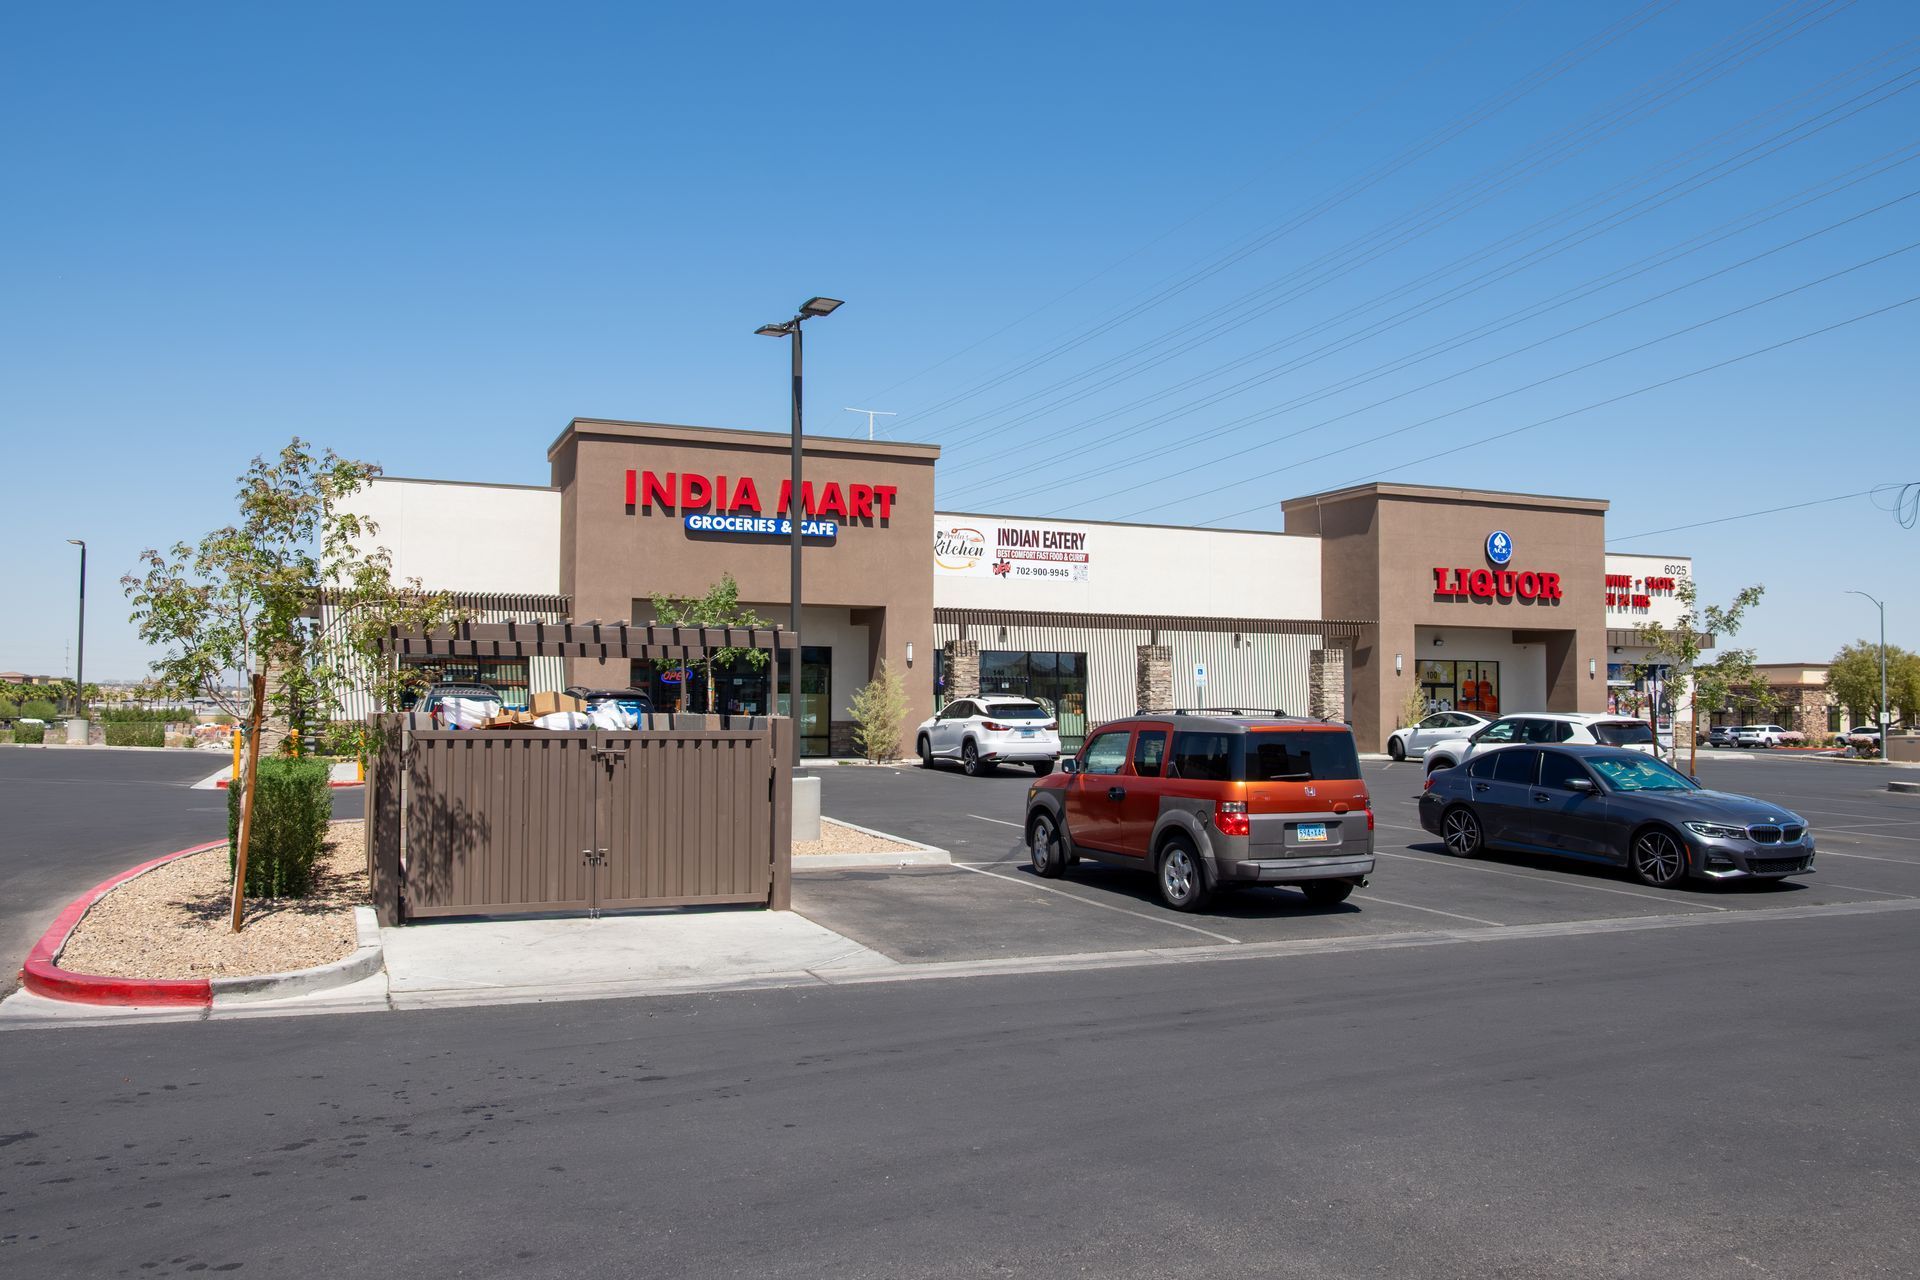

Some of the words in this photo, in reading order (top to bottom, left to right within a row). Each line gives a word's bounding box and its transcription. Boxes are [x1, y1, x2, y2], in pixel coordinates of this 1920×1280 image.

[626, 470, 762, 512] INDIA
[777, 480, 897, 519] MART
[689, 516, 775, 532] GROCERIES
[781, 522, 792, 533] &
[801, 522, 834, 535] CAFE
[998, 528, 1039, 548] INDIAN
[1043, 531, 1086, 550] EATERY
[934, 539, 985, 557] Kitchen
[998, 550, 1011, 558] BEST
[1011, 551, 1036, 559] COMFORT
[1037, 552, 1049, 560] FAST
[1069, 554, 1086, 562] CURRY
[1016, 567, 1069, 577] 702-900-9945
[1664, 565, 1687, 575] 6025
[1435, 567, 1562, 599] LIQUOR
[1645, 576, 1675, 590] SLOTS
[1632, 595, 1651, 607] HRS
[1426, 671, 1437, 679] 100
